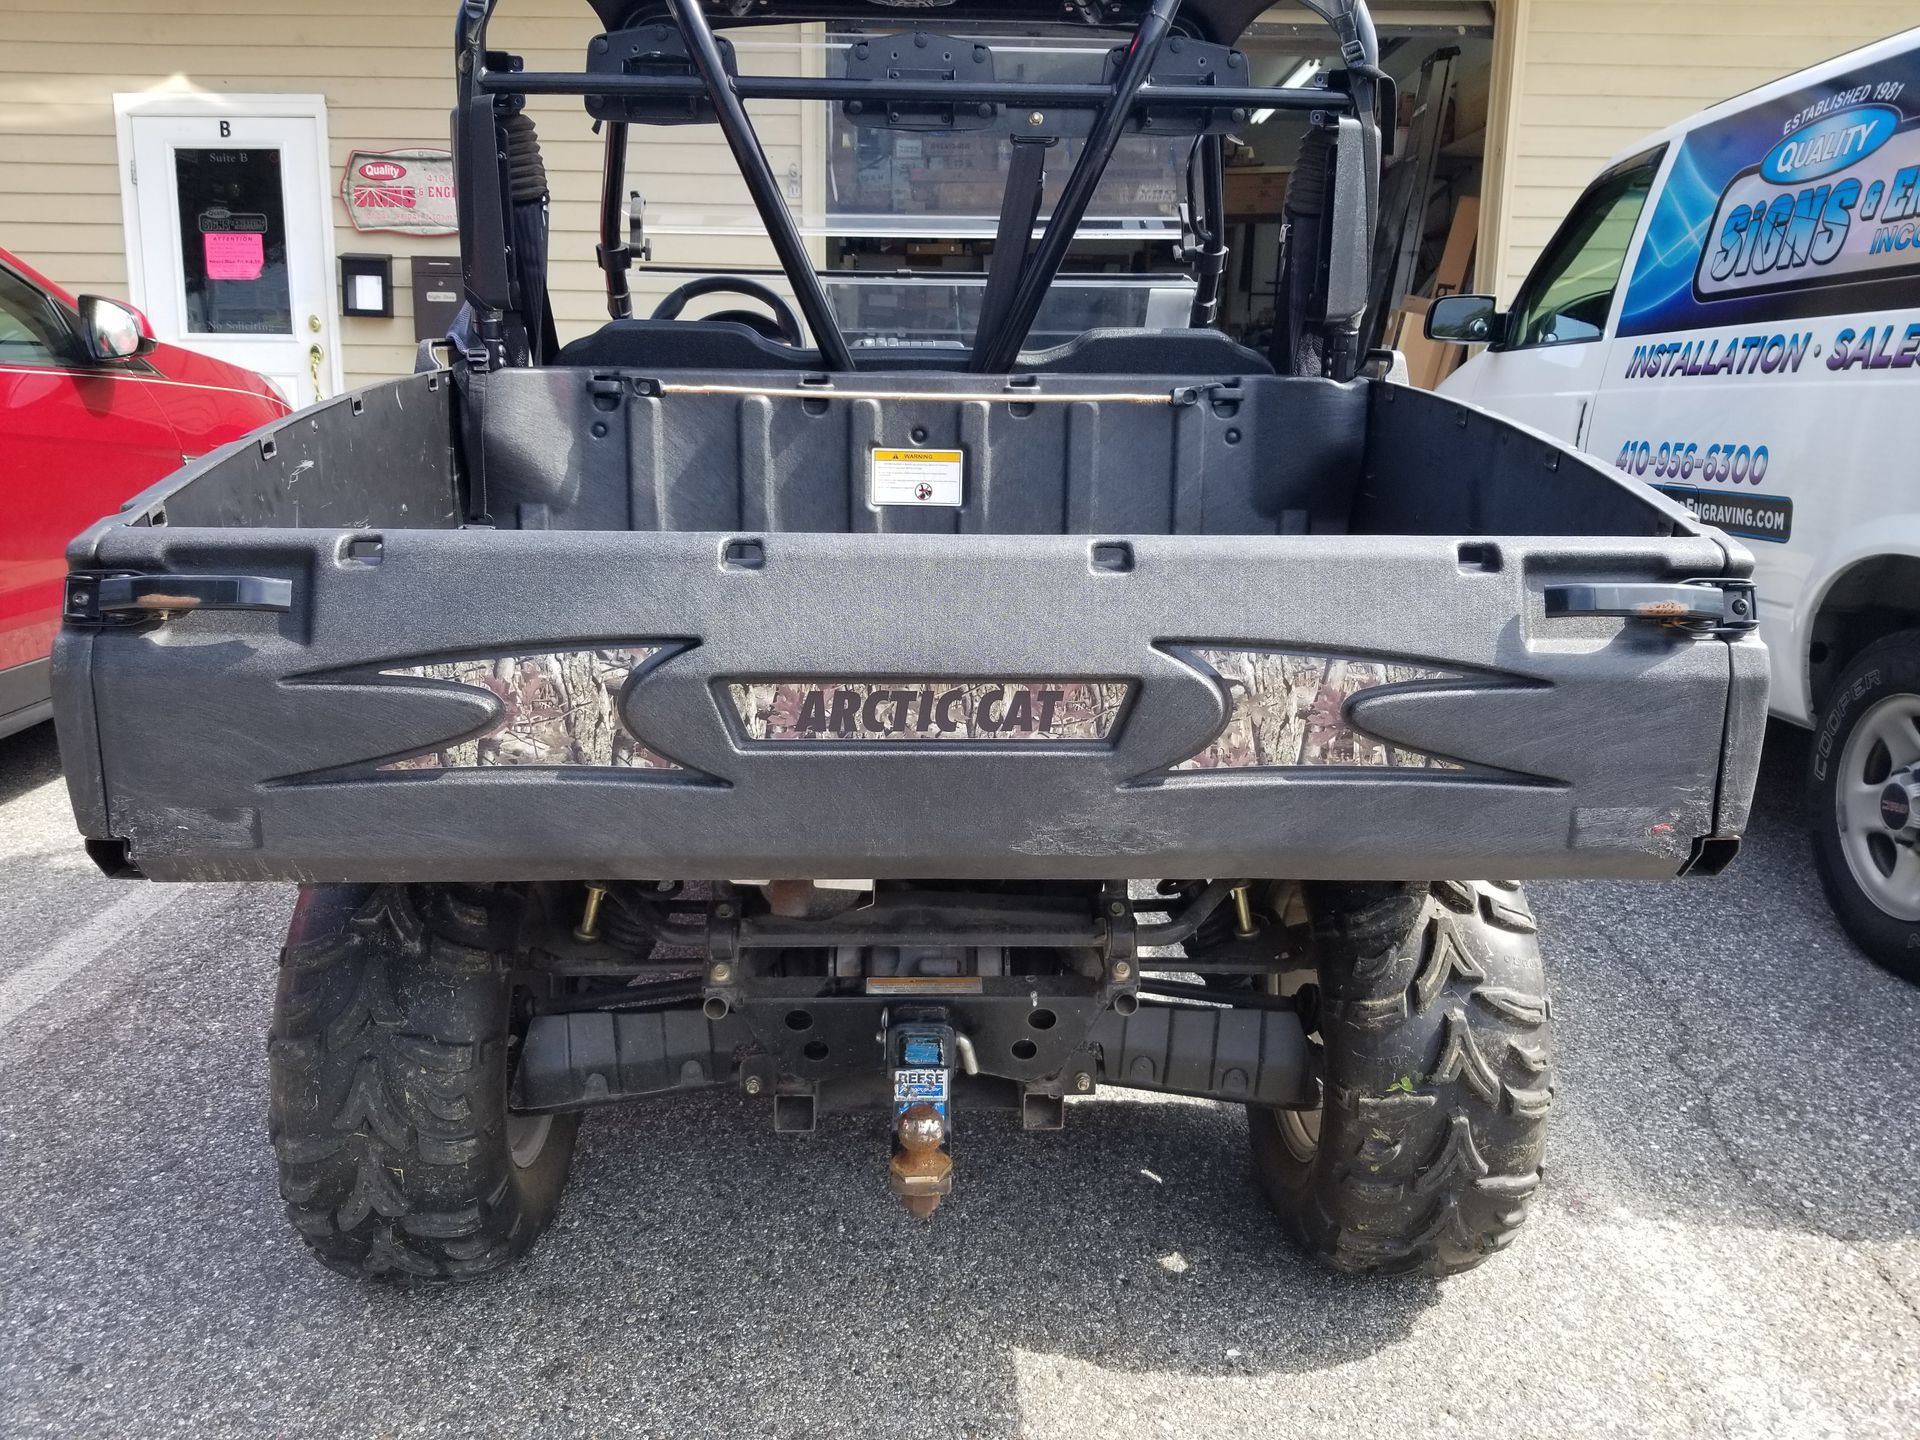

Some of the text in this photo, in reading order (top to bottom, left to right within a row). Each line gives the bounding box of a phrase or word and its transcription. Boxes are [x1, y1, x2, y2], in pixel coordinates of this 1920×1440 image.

[219, 120, 232, 138] B
[1783, 81, 1905, 135] ESTABLISHED 1981
[209, 153, 249, 163] Suite B
[1776, 119, 1879, 173] QUALITY
[365, 165, 400, 178] Quality
[207, 320, 222, 330] No
[1624, 332, 1813, 379] INSTALLATION
[1615, 440, 1769, 486] 410-956-6300
[796, 690, 1065, 733] ARCTIC CAT
[1813, 668, 1882, 781] COOPER
